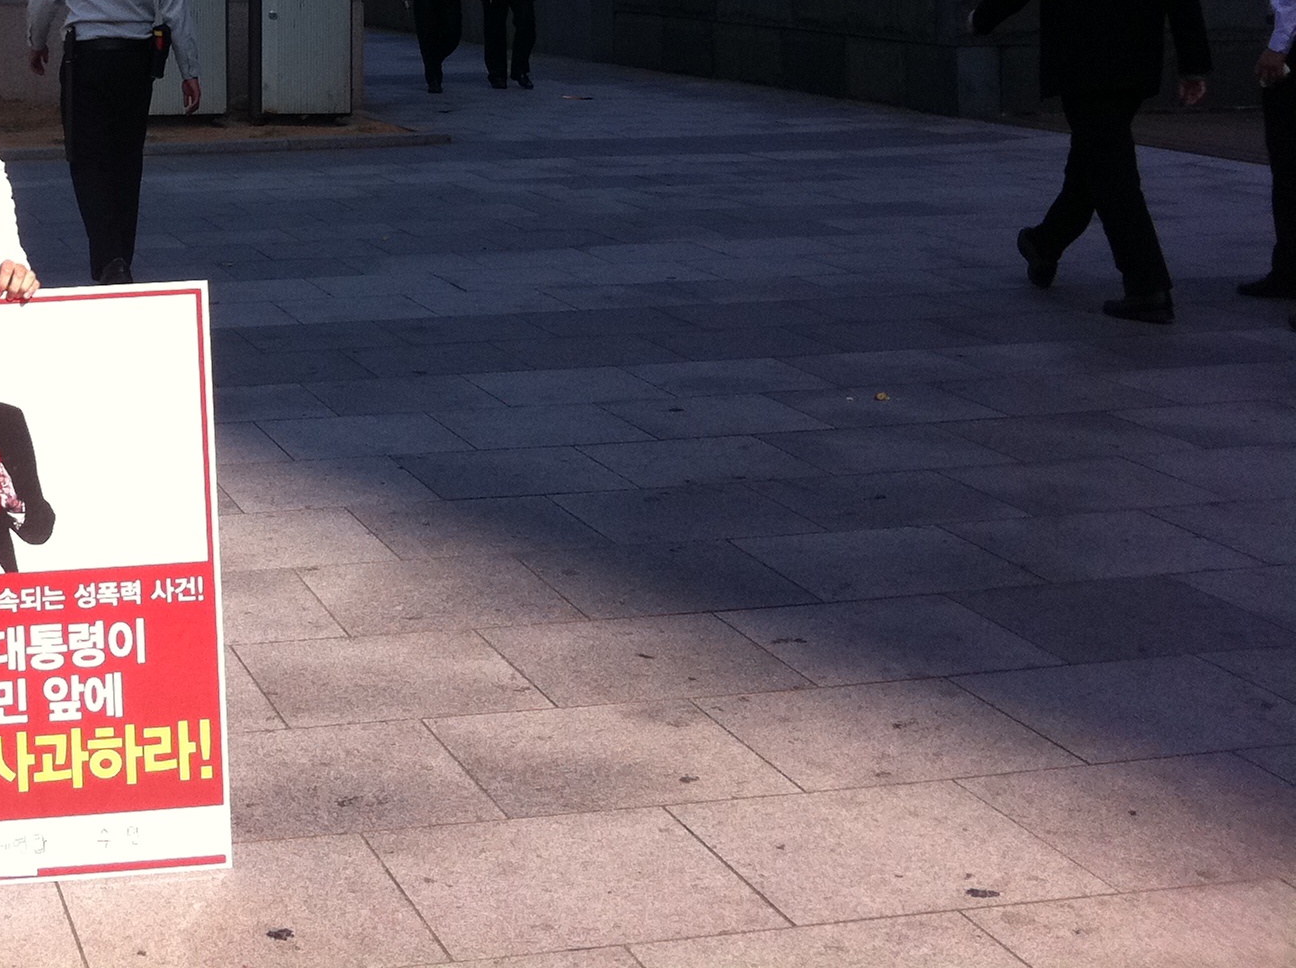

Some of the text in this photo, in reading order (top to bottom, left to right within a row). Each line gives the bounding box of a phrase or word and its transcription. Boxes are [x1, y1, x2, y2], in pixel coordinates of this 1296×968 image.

[74, 579, 143, 609] 성폭력
[150, 575, 205, 603] 사건!
[43, 671, 124, 722] 앞에
